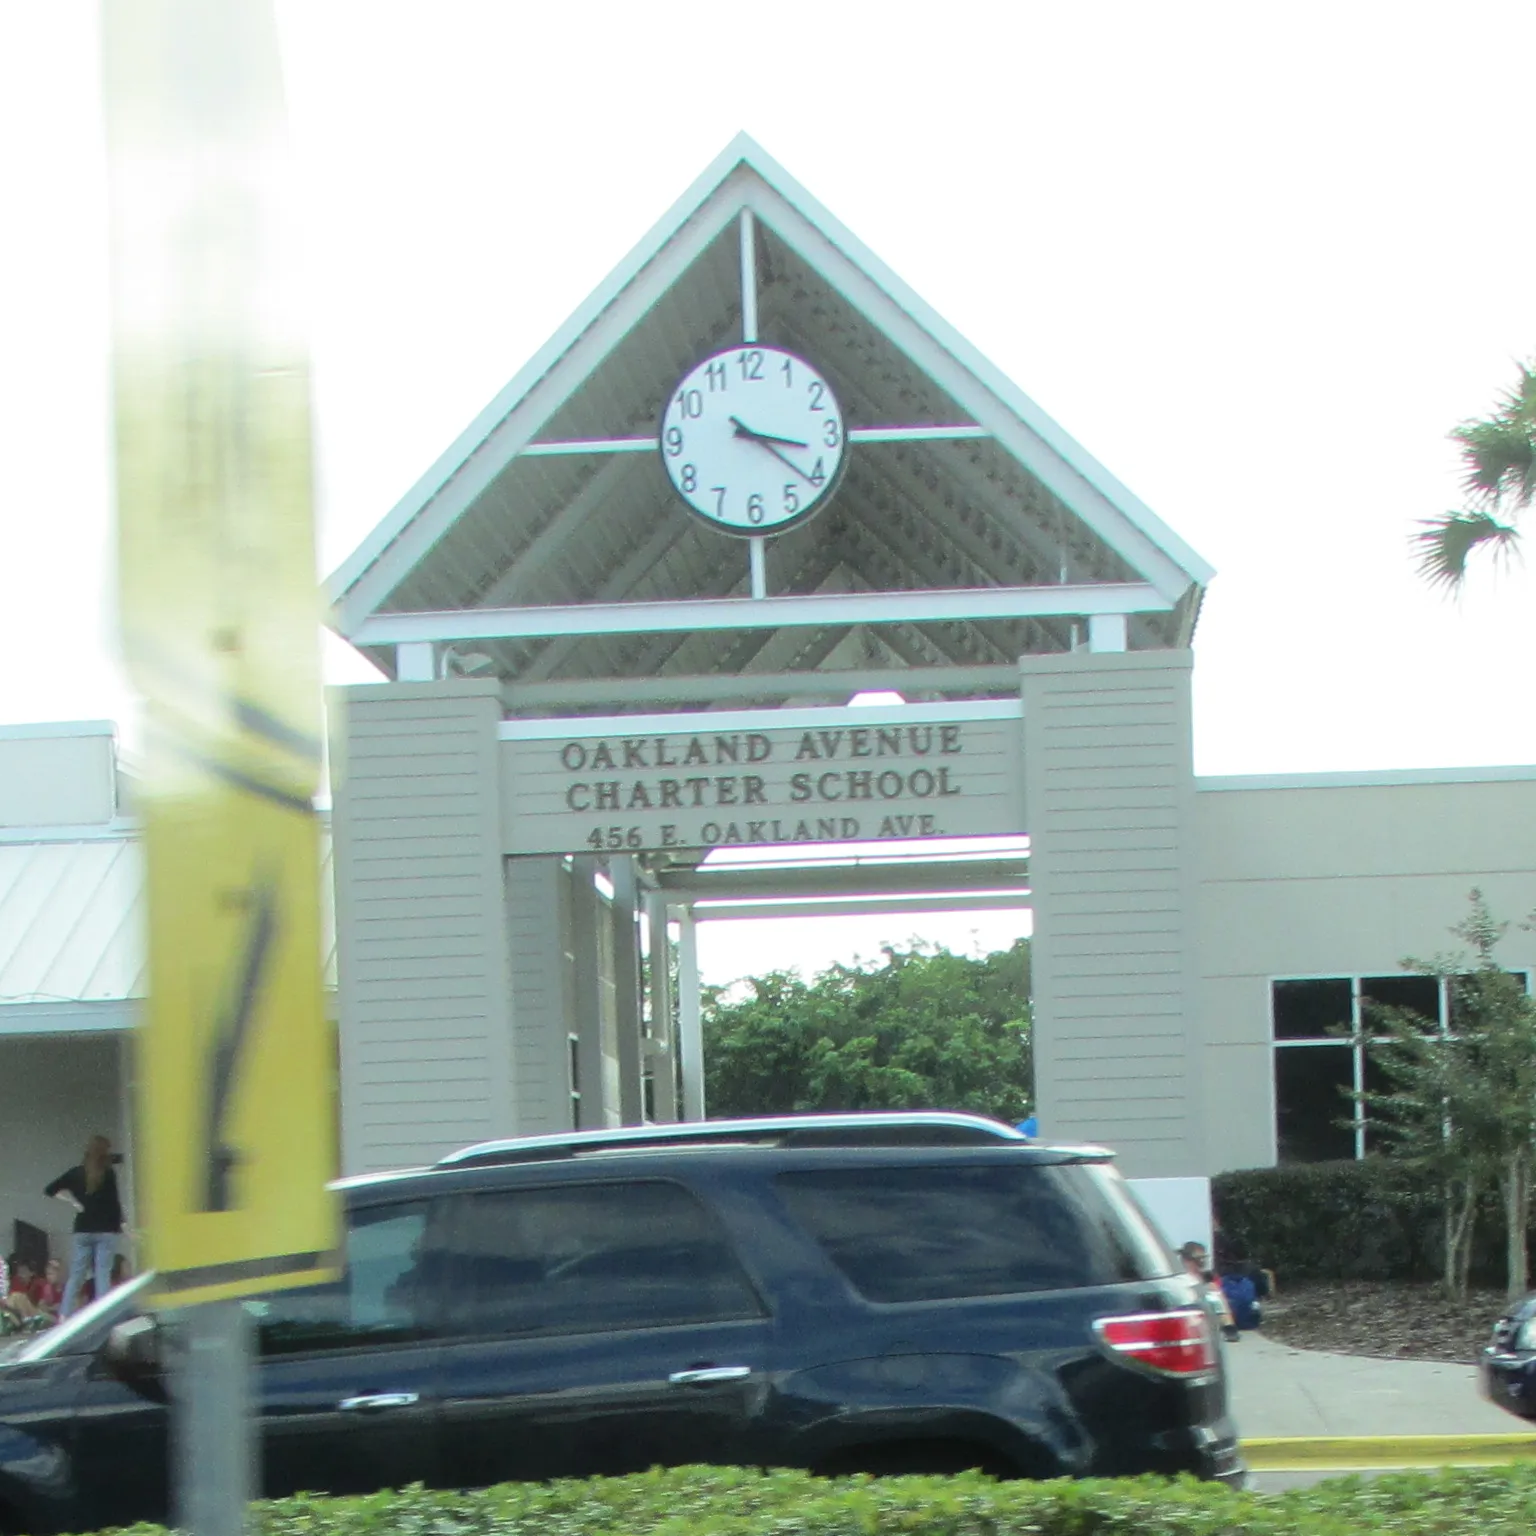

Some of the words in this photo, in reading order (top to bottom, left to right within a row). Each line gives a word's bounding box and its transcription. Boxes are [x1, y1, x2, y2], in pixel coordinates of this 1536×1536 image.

[705, 362, 727, 392] 11
[736, 351, 764, 381] 12
[780, 359, 793, 388] 1
[675, 389, 703, 420] 10
[808, 381, 825, 412] 2
[666, 426, 683, 457] 9
[823, 419, 839, 448] 3
[680, 464, 696, 493] 8
[710, 486, 727, 517] 7
[747, 494, 764, 524] 6
[784, 484, 799, 513] 5
[562, 733, 772, 771] OAKLAND
[795, 725, 963, 760] AVENUE
[566, 775, 768, 812] CHARTER
[790, 766, 961, 802] SCHOOL
[586, 825, 643, 849] 456
[659, 824, 686, 846] E.
[701, 817, 861, 845] OAKLAND
[877, 814, 946, 838] AVE.
